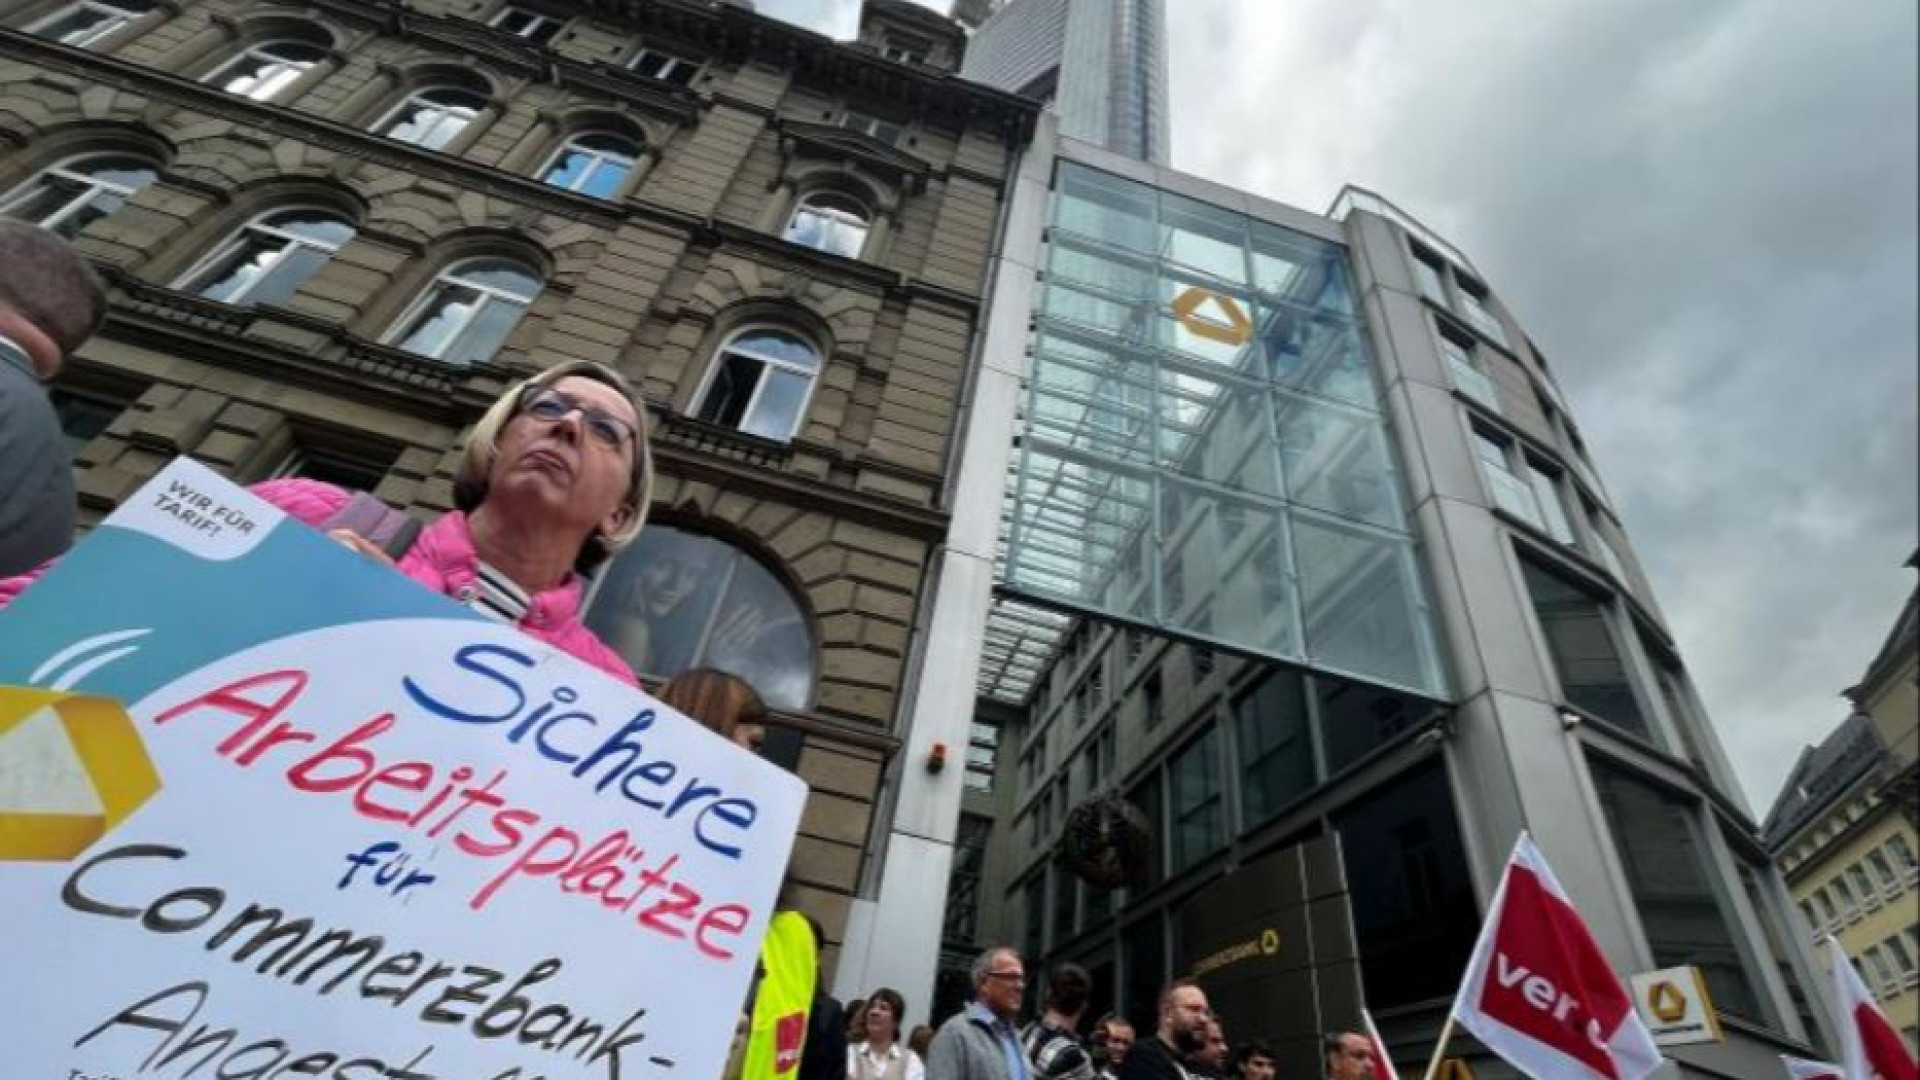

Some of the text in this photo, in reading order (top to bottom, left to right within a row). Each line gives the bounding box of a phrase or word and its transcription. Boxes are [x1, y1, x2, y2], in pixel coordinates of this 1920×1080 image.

[154, 493, 222, 537] TARIF!
[169, 480, 256, 535] WIR FÜR
[154, 669, 750, 961] Arbeitsplätze
[402, 643, 758, 859] Sichere
[61, 844, 675, 1080] Commerzbank-
